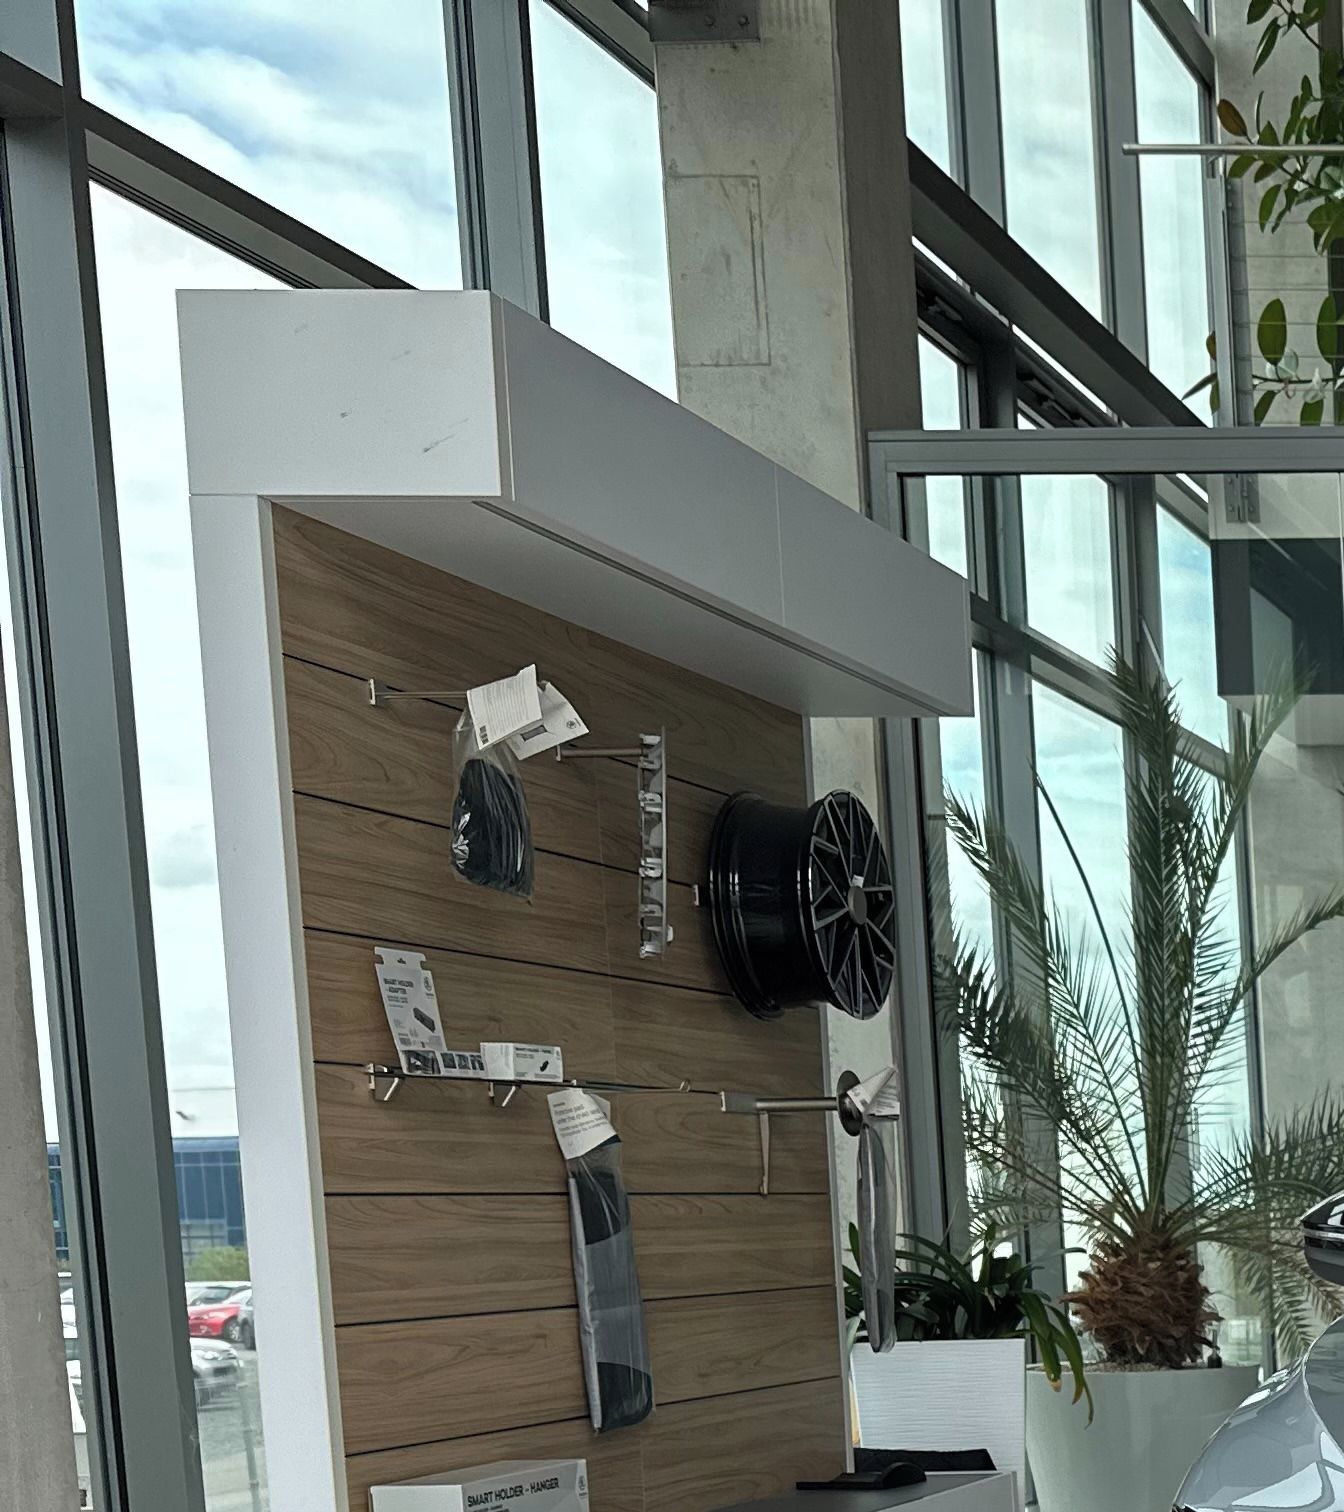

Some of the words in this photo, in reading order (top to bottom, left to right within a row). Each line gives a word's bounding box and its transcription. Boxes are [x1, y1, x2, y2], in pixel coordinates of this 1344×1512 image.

[468, 1491, 493, 1507] SMART
[495, 1485, 524, 1501] HOLDER
[531, 1477, 559, 1494] HANGER
